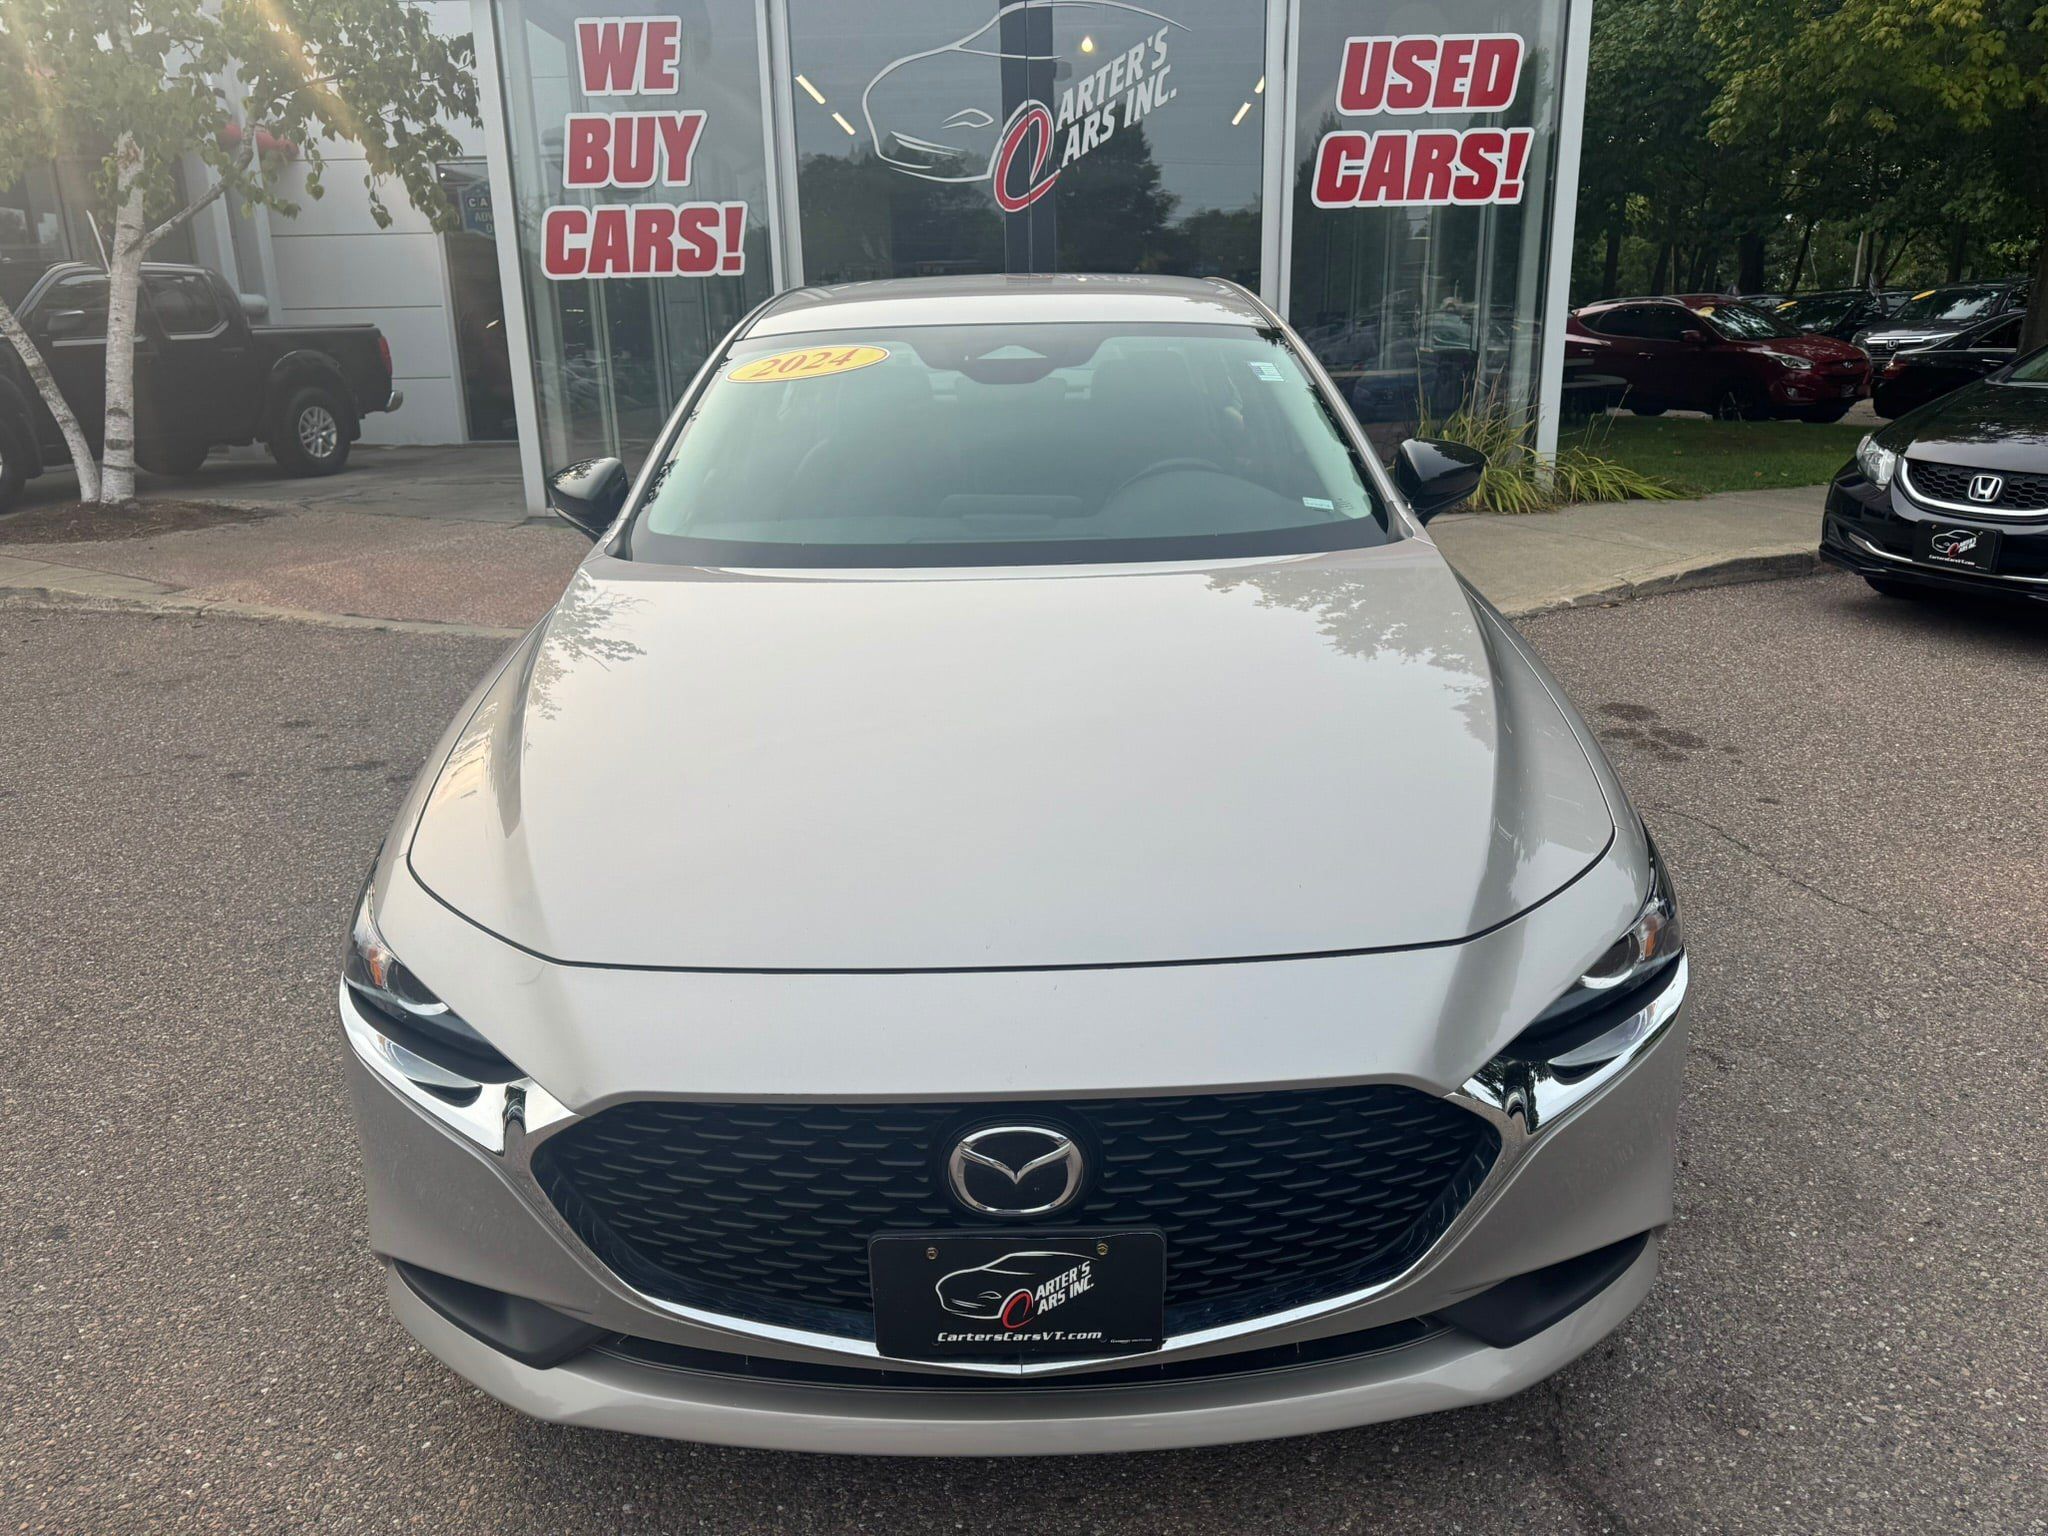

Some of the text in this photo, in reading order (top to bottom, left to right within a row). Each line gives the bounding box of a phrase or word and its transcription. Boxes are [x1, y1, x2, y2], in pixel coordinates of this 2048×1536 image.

[576, 18, 680, 94] WE
[1338, 35, 1523, 113] USED
[1124, 64, 1177, 129] INC.
[565, 112, 705, 187] BUY
[1313, 129, 1533, 207] CARS!
[543, 203, 746, 278] CARS!
[750, 348, 861, 378] 2024
[1070, 1274, 1095, 1299] INC.
[937, 1331, 1102, 1342] CartersCarsVT.com
